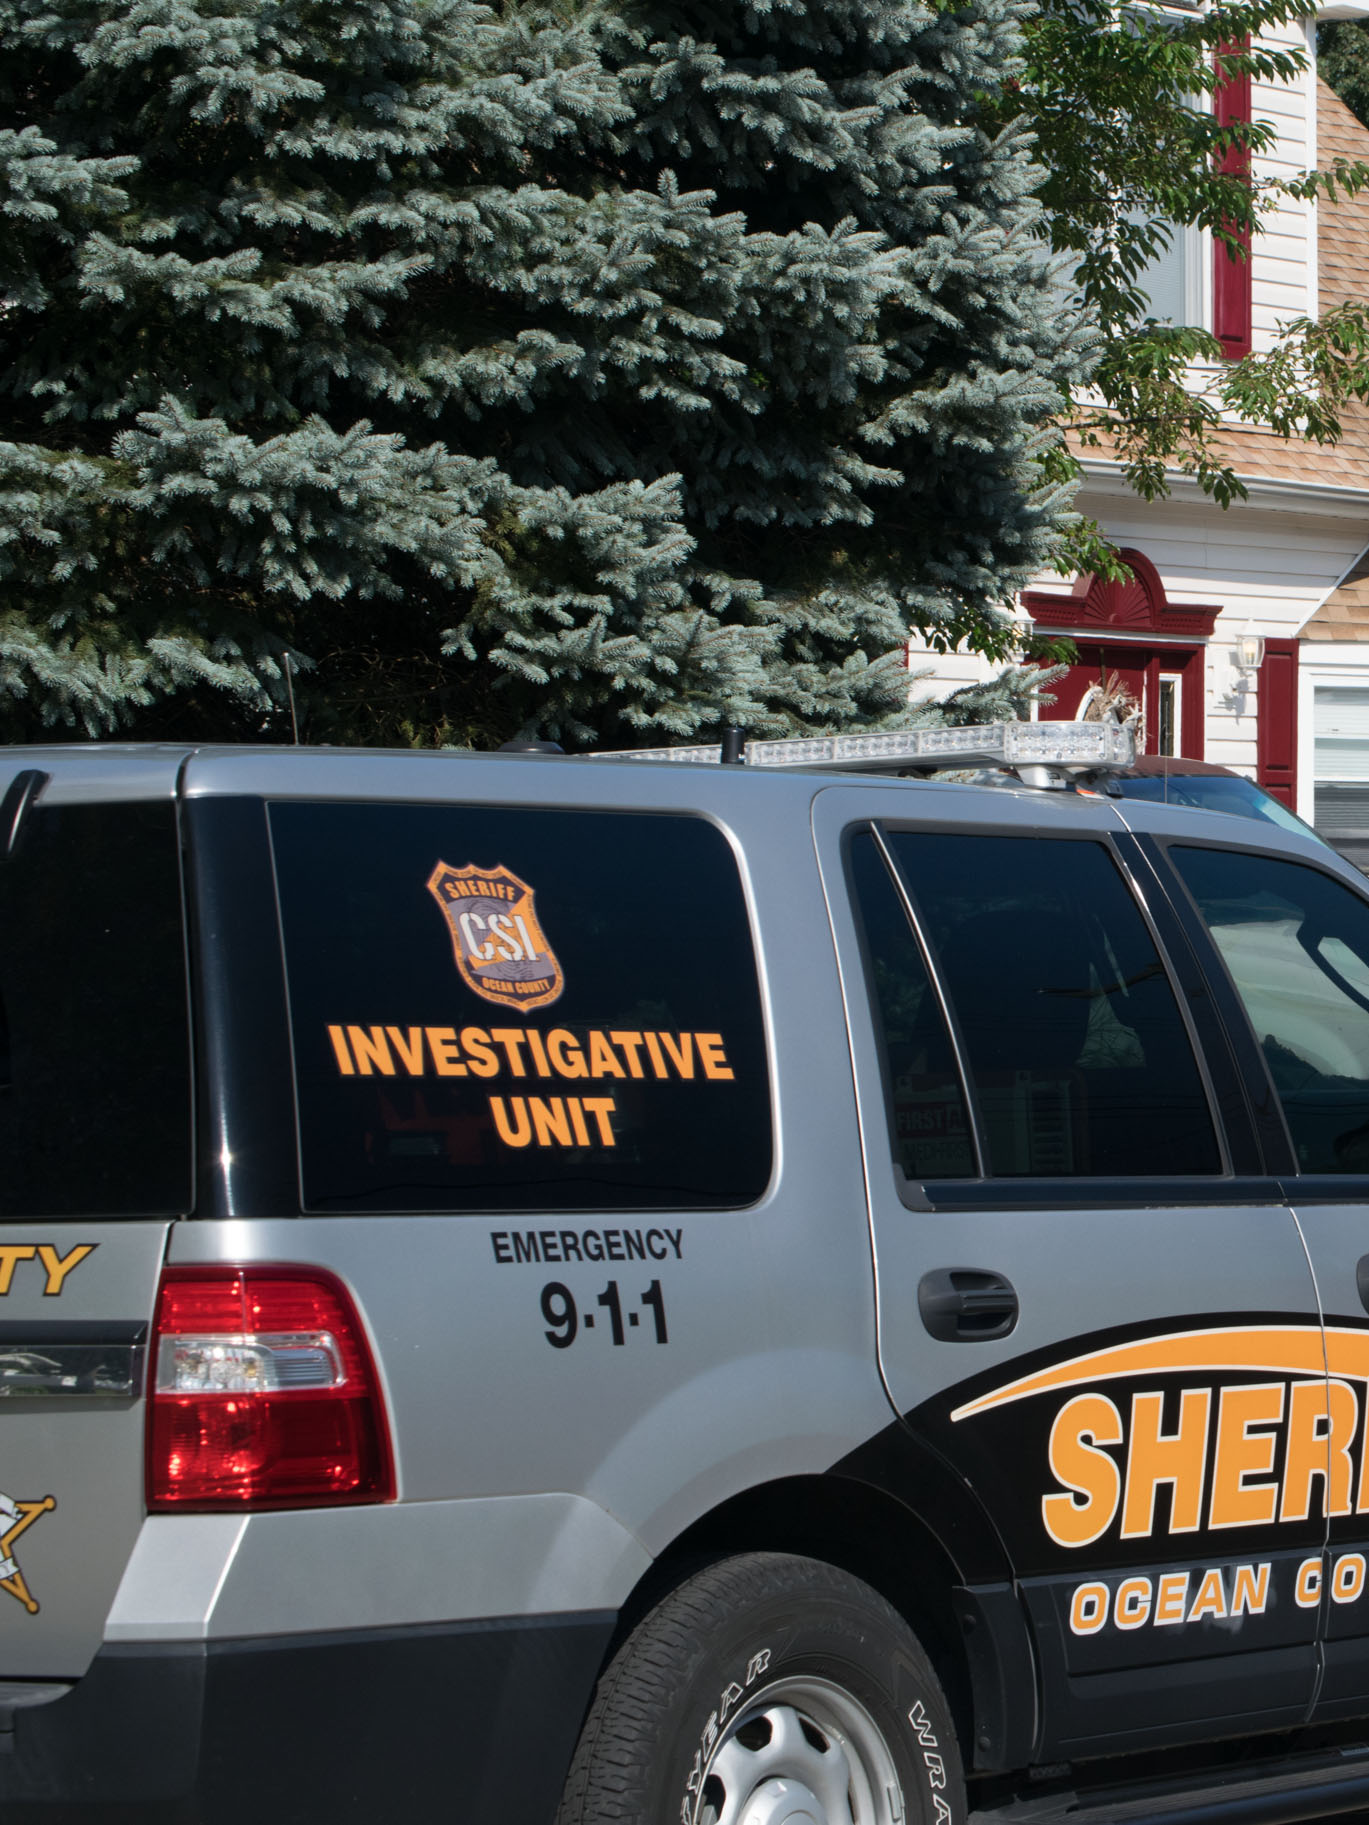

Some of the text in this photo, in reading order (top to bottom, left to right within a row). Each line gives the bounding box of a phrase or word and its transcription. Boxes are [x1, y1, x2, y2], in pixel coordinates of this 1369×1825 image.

[445, 880, 515, 900] SHERIFF
[459, 912, 538, 962] CSI
[482, 977, 551, 994] OCEAN COUNTY
[327, 1023, 735, 1081] INVESTIGATIVE
[489, 1096, 617, 1148] UNIT
[490, 1228, 683, 1263] EMERGENCY
[1069, 1562, 1271, 1636] OCEAN
